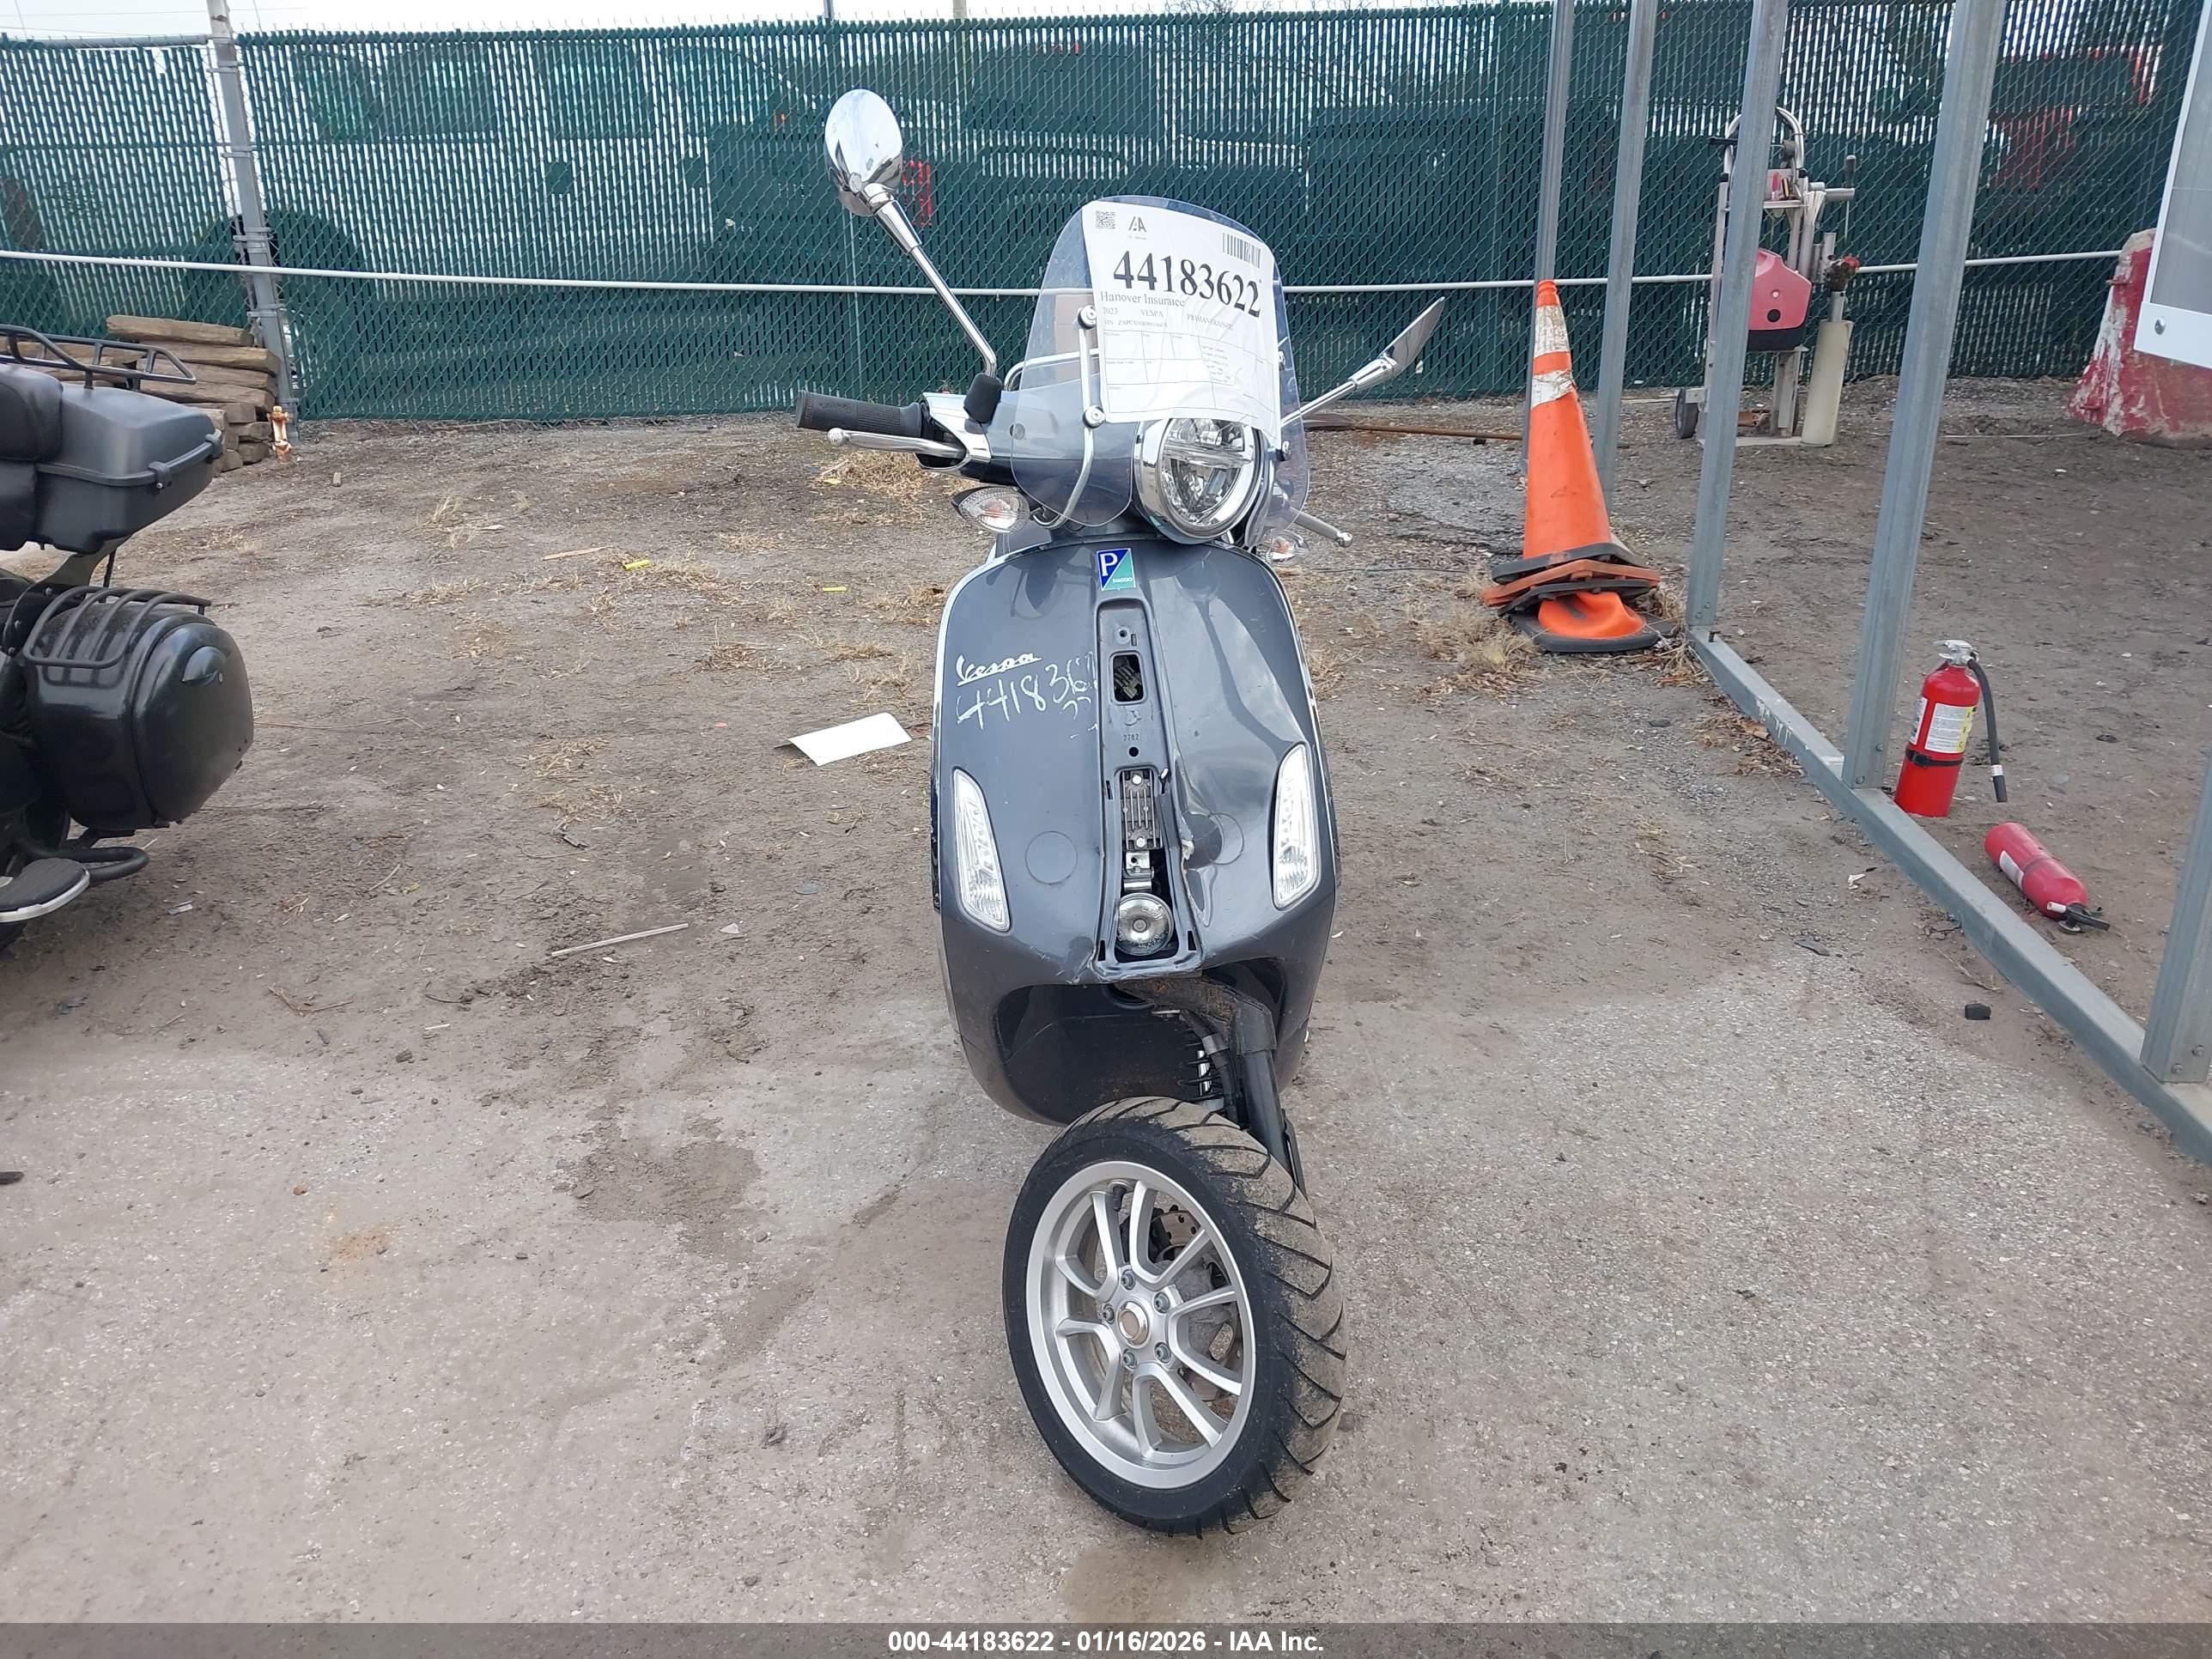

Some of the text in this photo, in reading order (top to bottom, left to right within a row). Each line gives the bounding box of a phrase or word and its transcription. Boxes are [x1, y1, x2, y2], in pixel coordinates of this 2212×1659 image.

[1100, 290, 1141, 304] Hanover
[1113, 250, 1261, 319] 44183622
[1100, 552, 1118, 576] P
[956, 652, 1042, 687] Vespa
